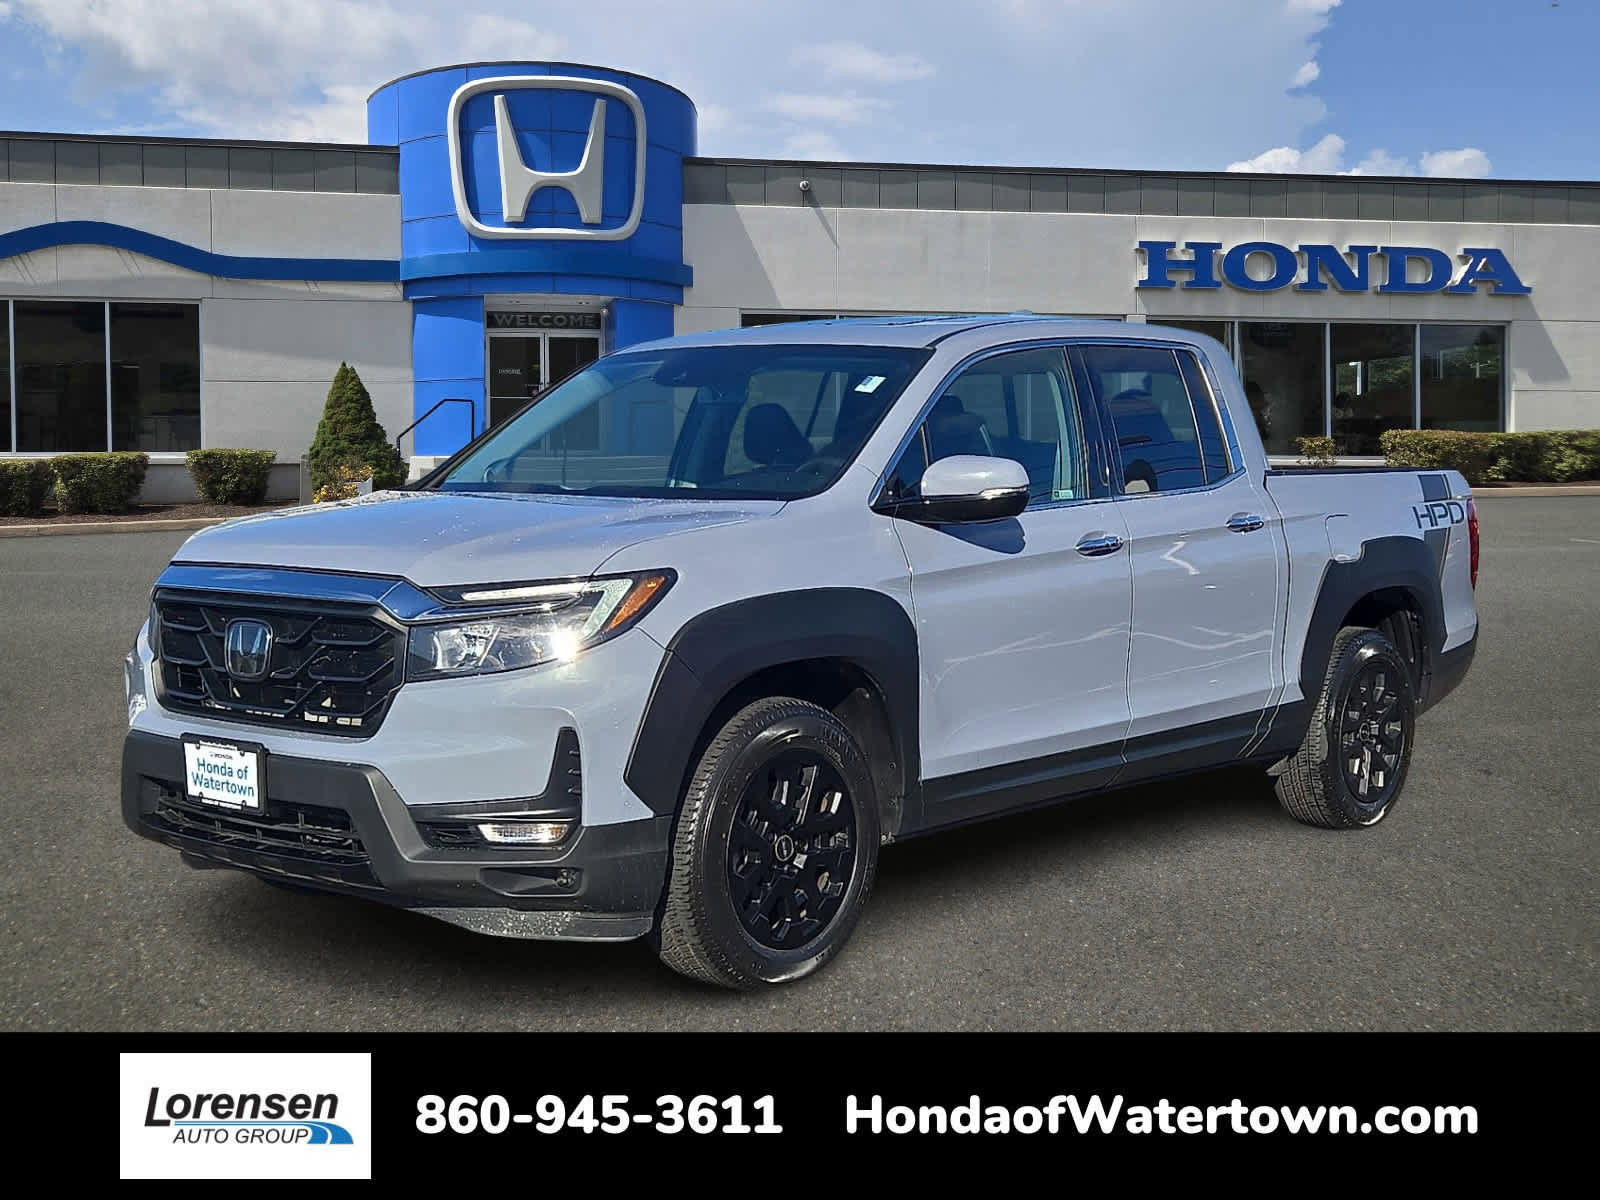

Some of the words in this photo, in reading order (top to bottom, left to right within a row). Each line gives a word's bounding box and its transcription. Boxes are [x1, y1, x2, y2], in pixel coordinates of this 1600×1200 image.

[1137, 241, 1532, 295] HONDA
[493, 312, 597, 327] WELCOME
[1412, 501, 1465, 529] HPD
[197, 758, 234, 777] Honda
[236, 766, 249, 780] of
[191, 772, 254, 797] Watertown
